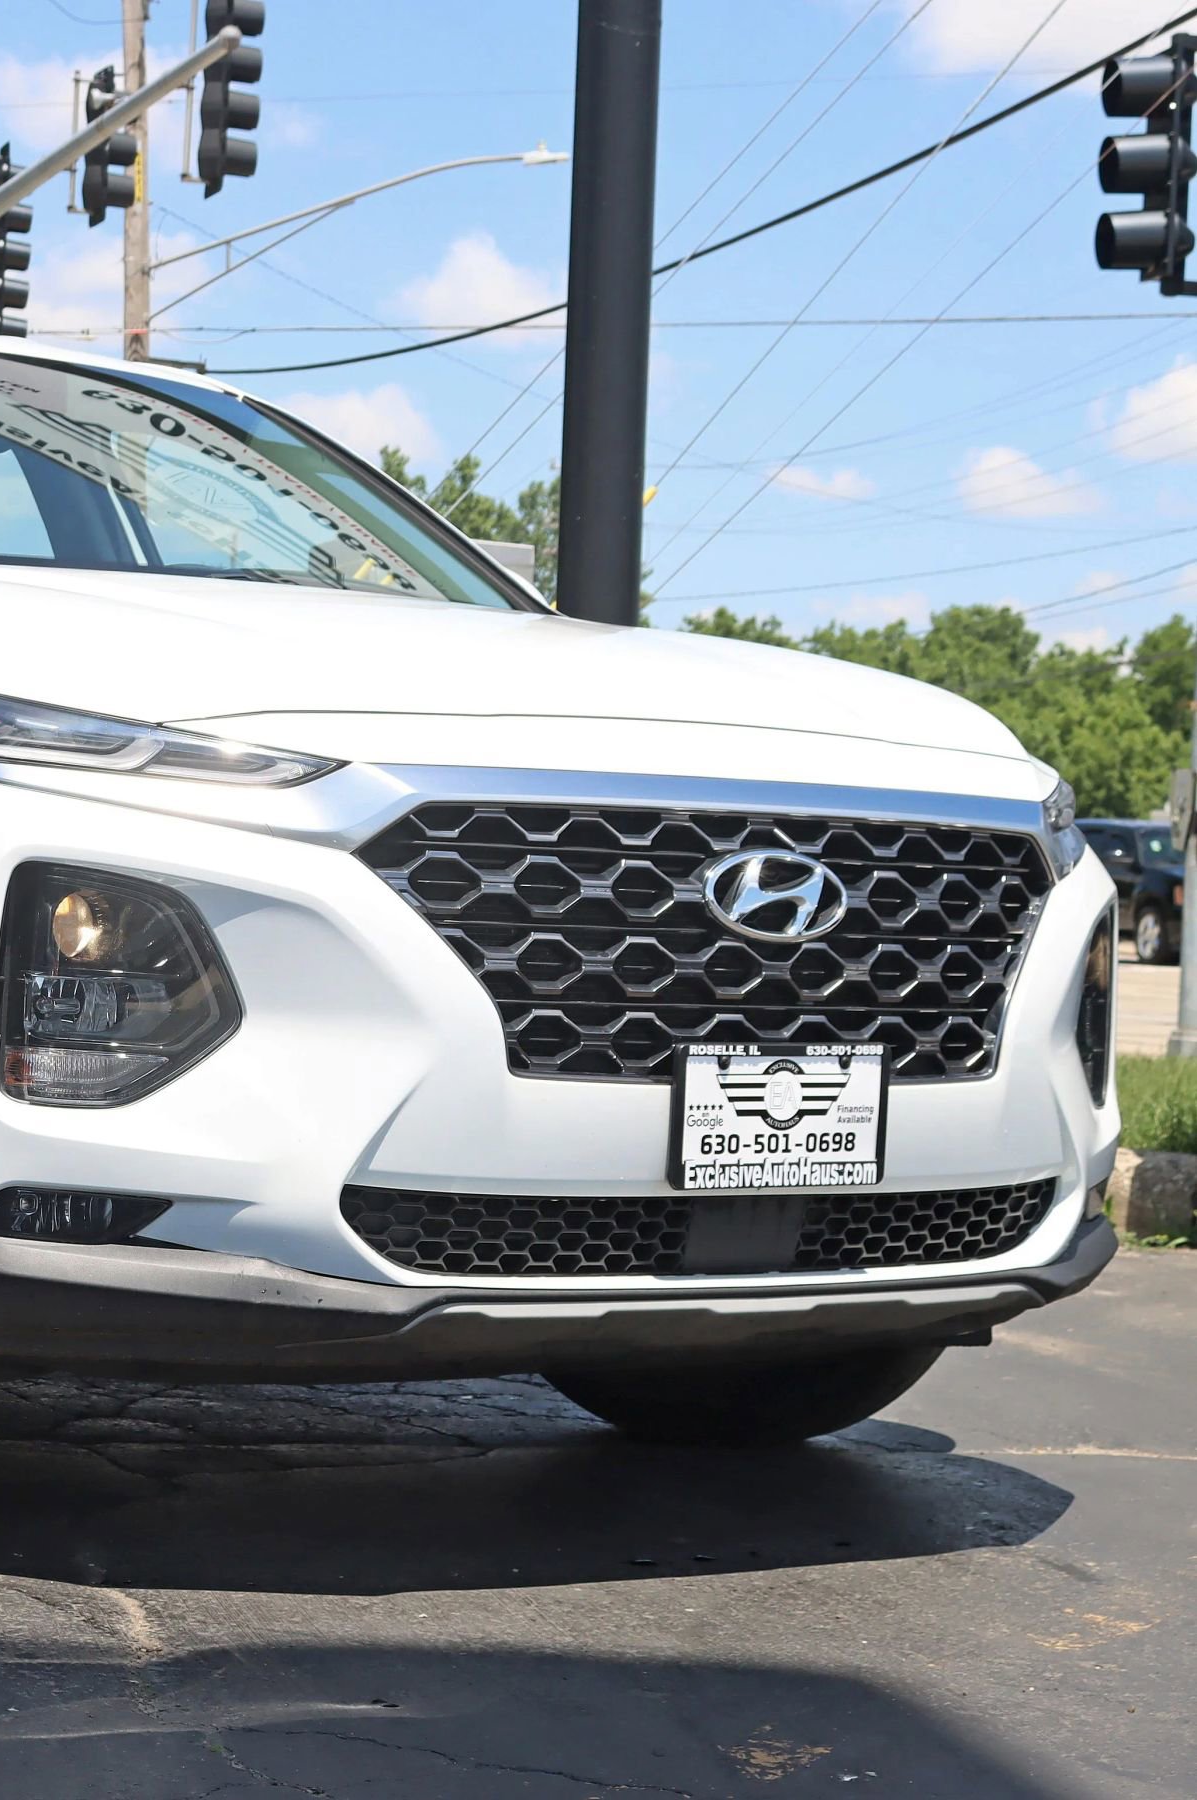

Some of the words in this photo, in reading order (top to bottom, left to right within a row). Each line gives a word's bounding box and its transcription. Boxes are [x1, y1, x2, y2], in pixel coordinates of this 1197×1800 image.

[689, 1045, 747, 1057] ROSELLE,
[749, 1045, 762, 1056] IL
[806, 1045, 884, 1056] 630-501-0698
[768, 1061, 800, 1074] EXCLUSIVE
[837, 1105, 875, 1115] Financing
[686, 1114, 724, 1130] Google
[765, 1116, 800, 1129] AUTOHAUS
[837, 1115, 873, 1124] Available
[700, 1132, 856, 1155] 630-501-0698
